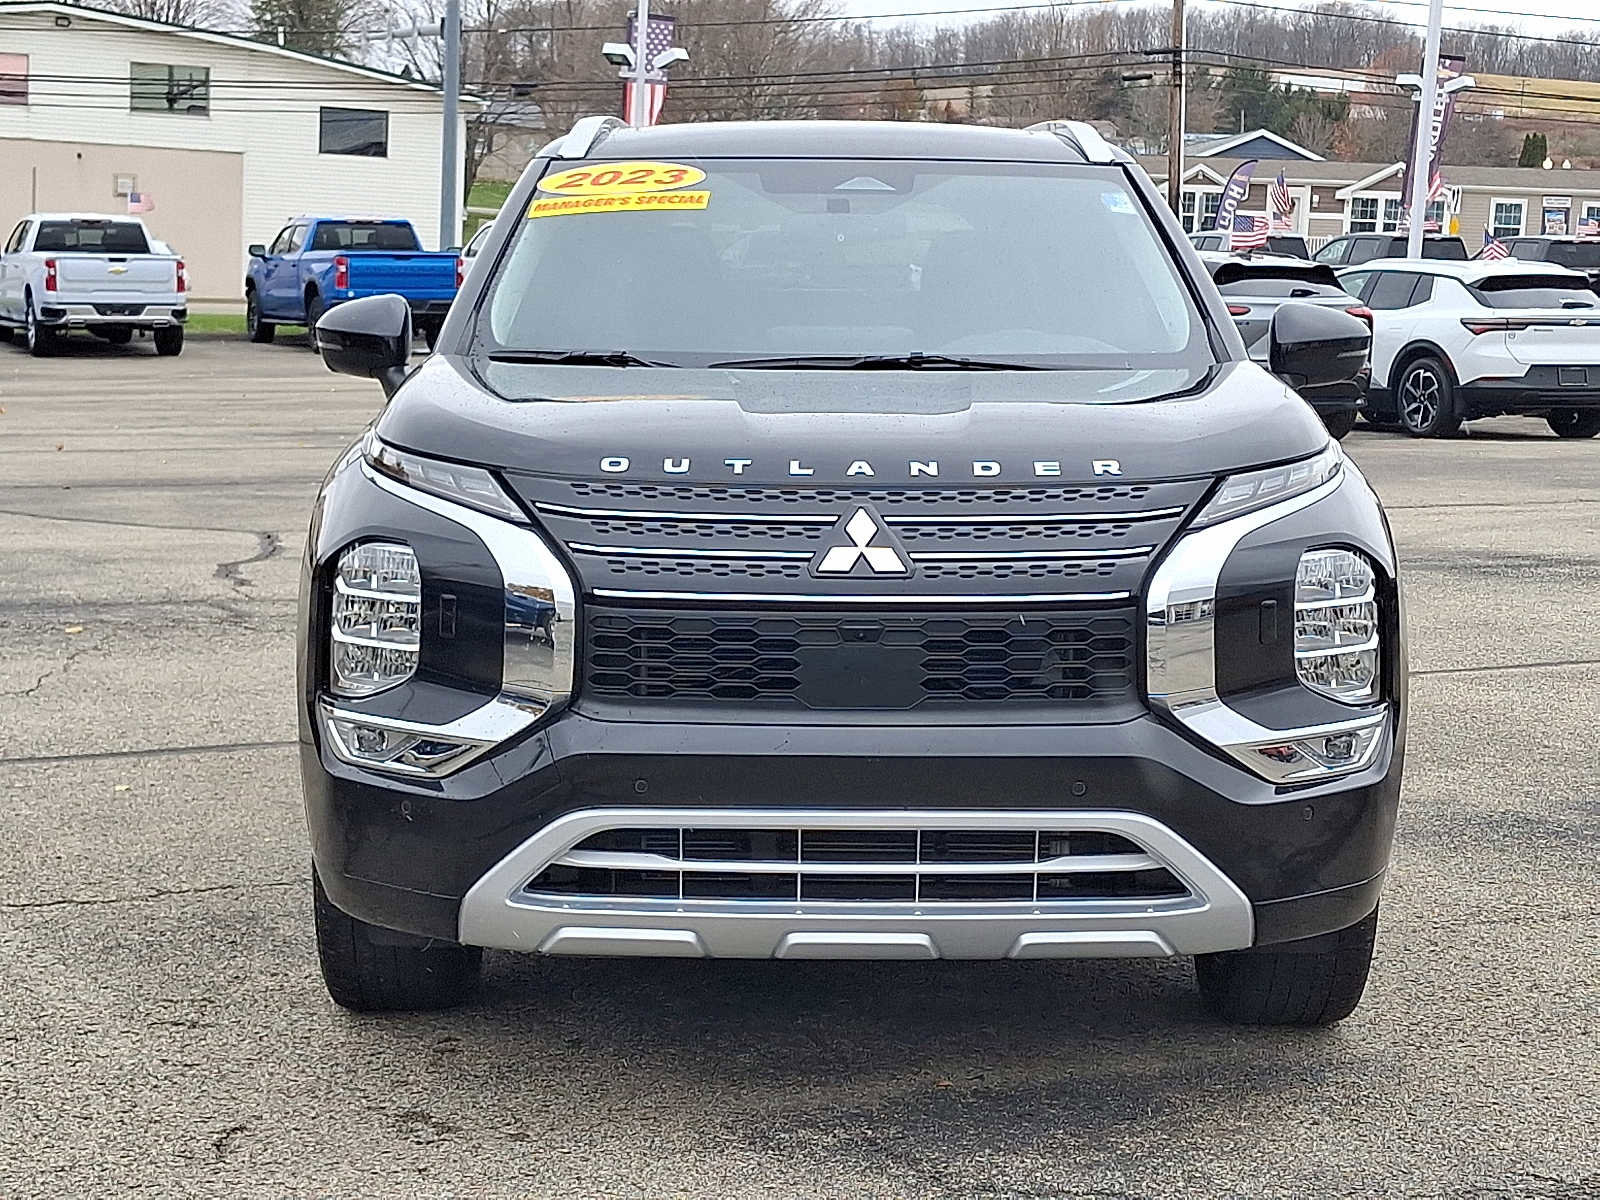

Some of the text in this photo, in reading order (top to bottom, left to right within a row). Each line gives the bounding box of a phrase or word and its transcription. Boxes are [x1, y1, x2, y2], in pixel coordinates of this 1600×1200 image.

[555, 169, 689, 189] 2023
[533, 194, 706, 212] MANAGER'S SPECIAL
[599, 456, 1125, 478] OUTLANDER
